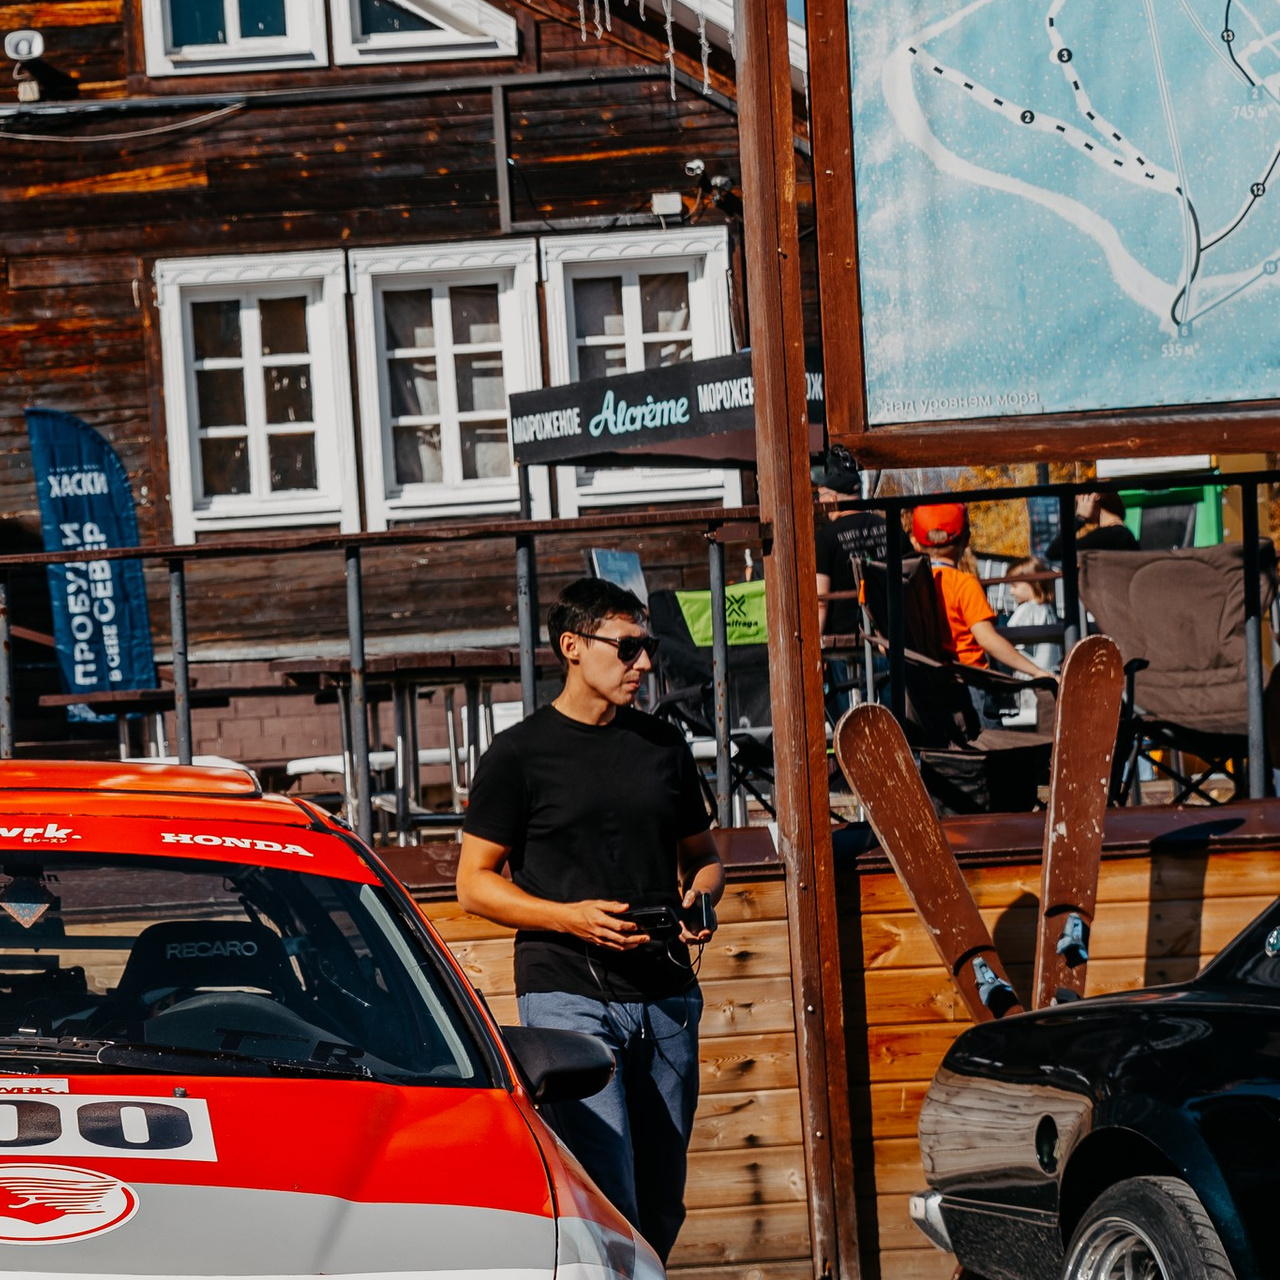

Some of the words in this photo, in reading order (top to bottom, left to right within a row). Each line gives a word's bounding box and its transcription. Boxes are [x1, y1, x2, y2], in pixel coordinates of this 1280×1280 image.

[1222, 31, 1234, 41] 13
[1061, 50, 1069, 61] 3
[1024, 112, 1031, 122] 2
[1252, 184, 1264, 195] 12
[1181, 325, 1189, 337] 6
[1161, 344, 1182, 358] 535
[996, 391, 1039, 408] моря
[512, 407, 582, 444] МОРОЖЕНОЕ
[47, 472, 109, 498] ХАСКИ
[161, 832, 314, 857] HONDA
[166, 940, 258, 960] RECARO
